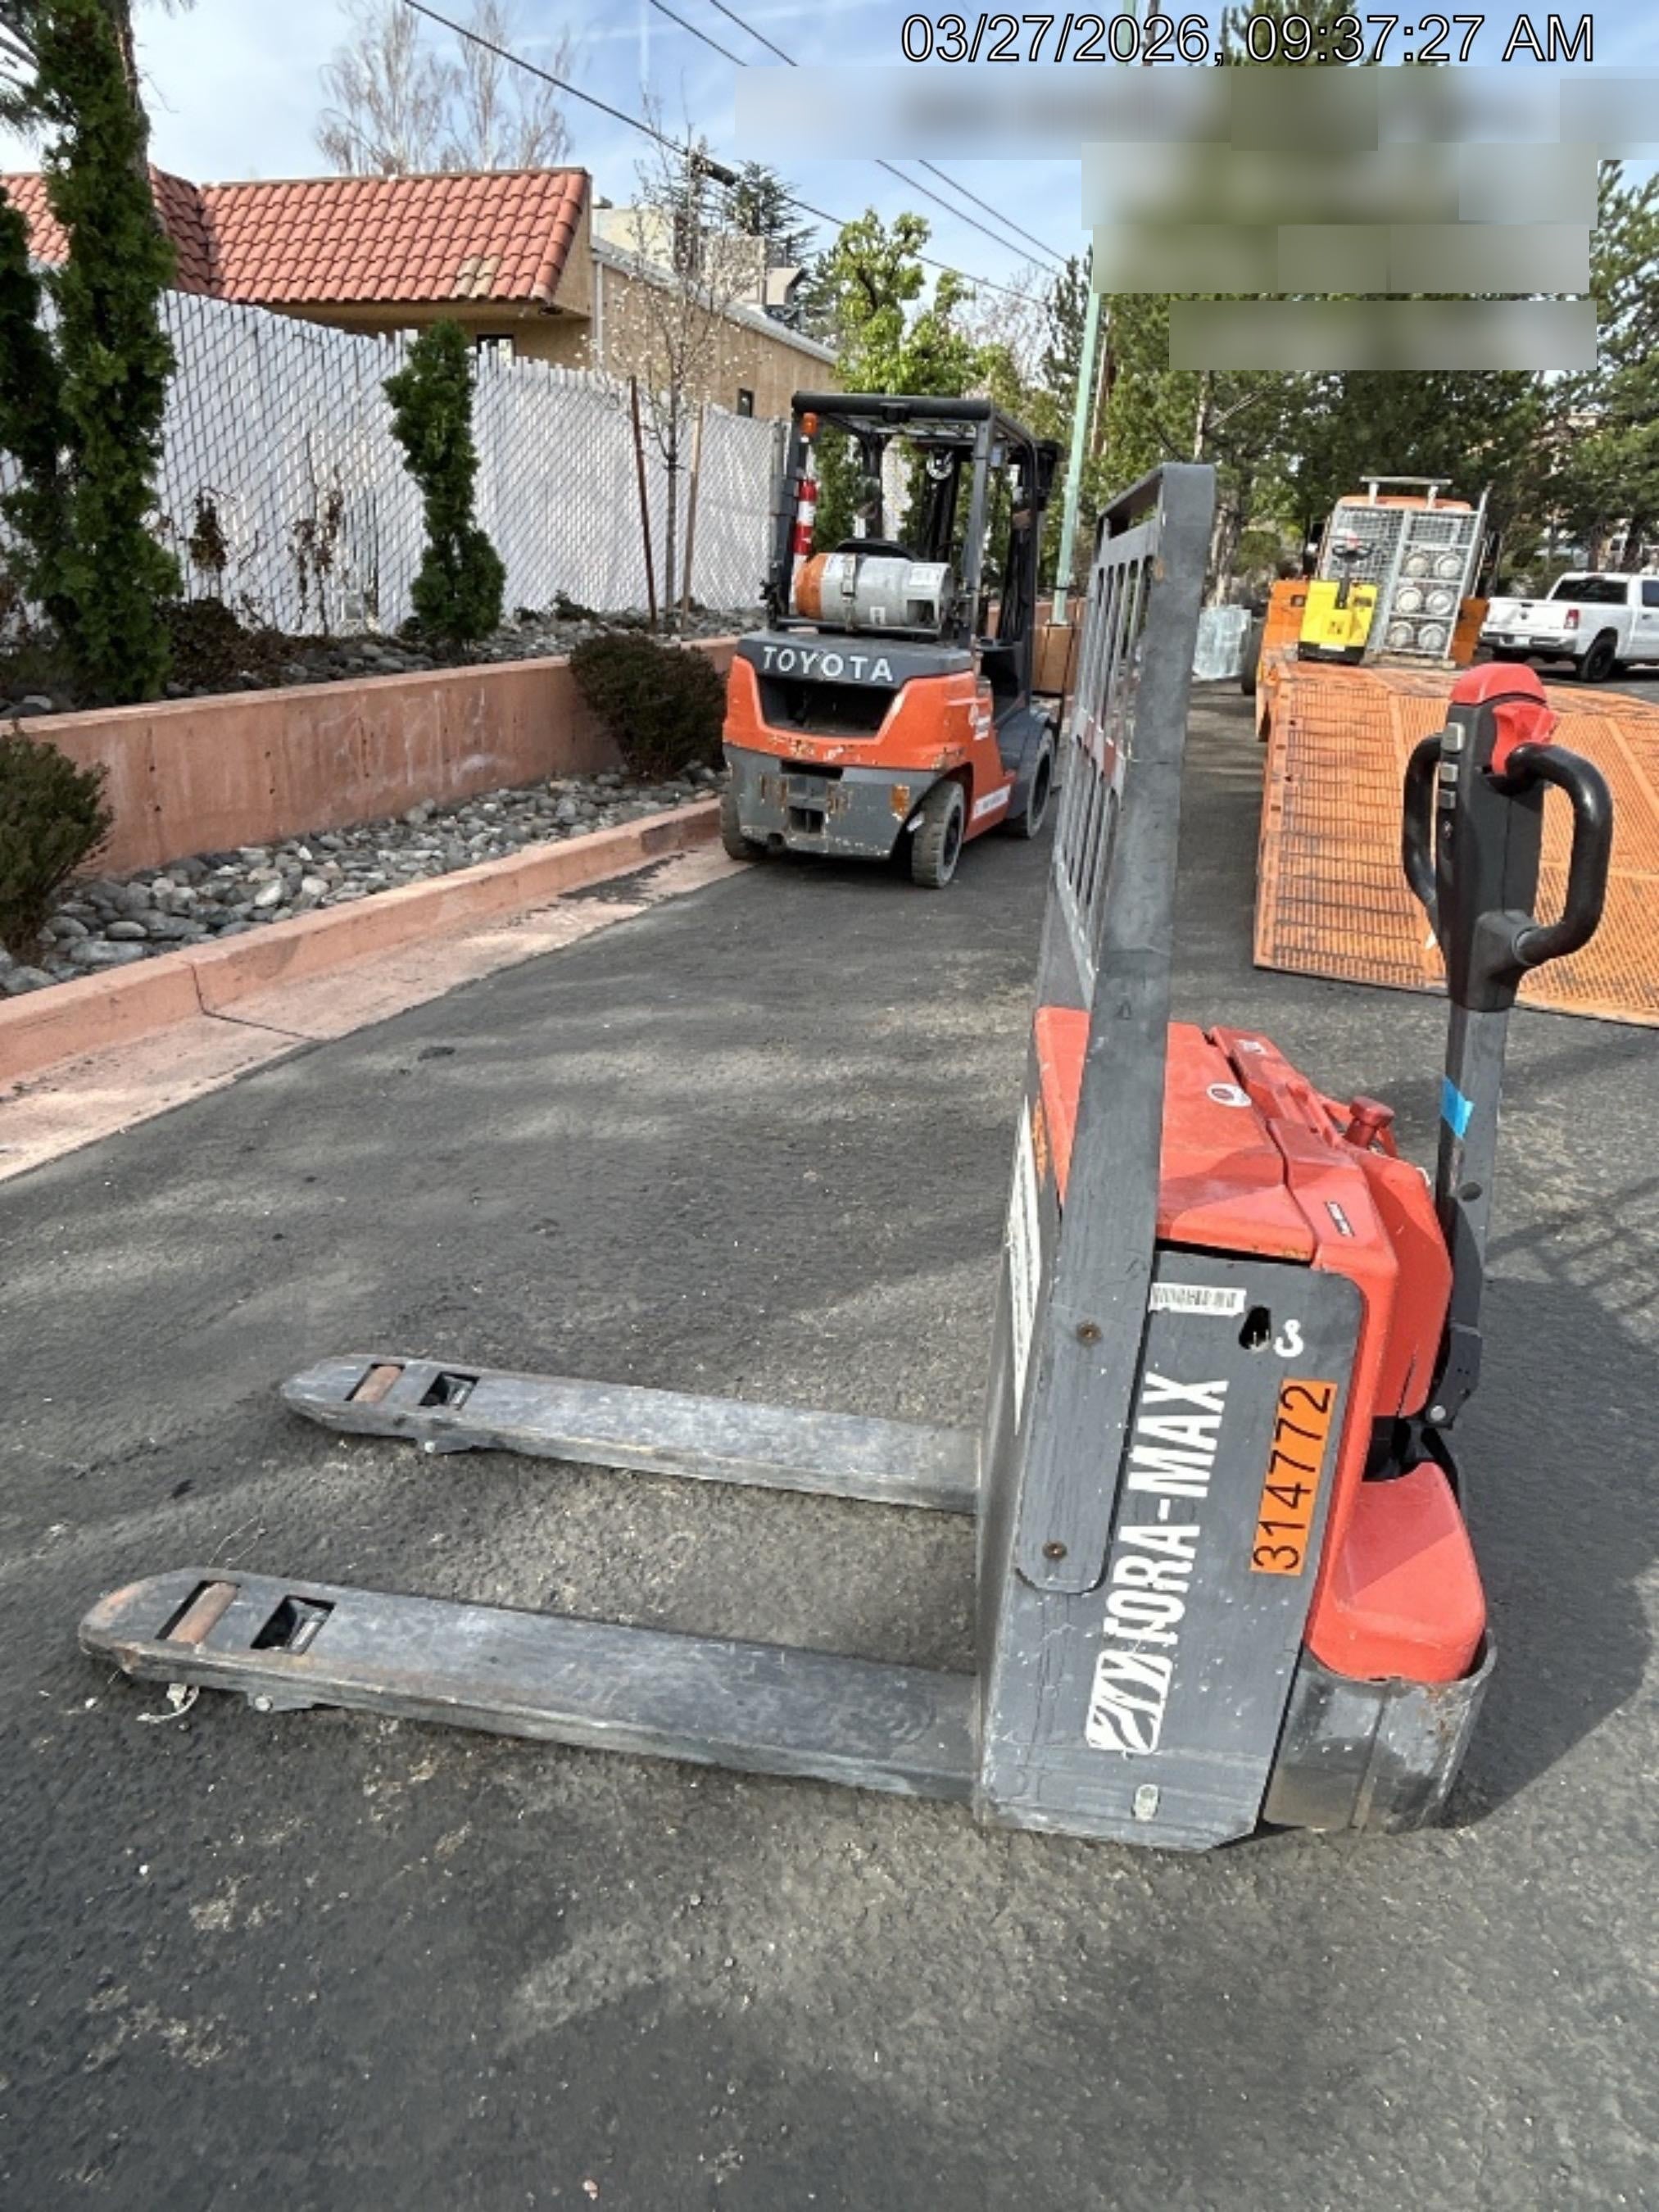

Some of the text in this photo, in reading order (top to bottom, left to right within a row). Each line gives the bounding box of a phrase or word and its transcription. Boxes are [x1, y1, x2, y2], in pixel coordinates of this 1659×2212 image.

[763, 646, 894, 682] TOYOTA
[1104, 1371, 1229, 1646] TORA-MAX
[1253, 1385, 1331, 1569] 314772
